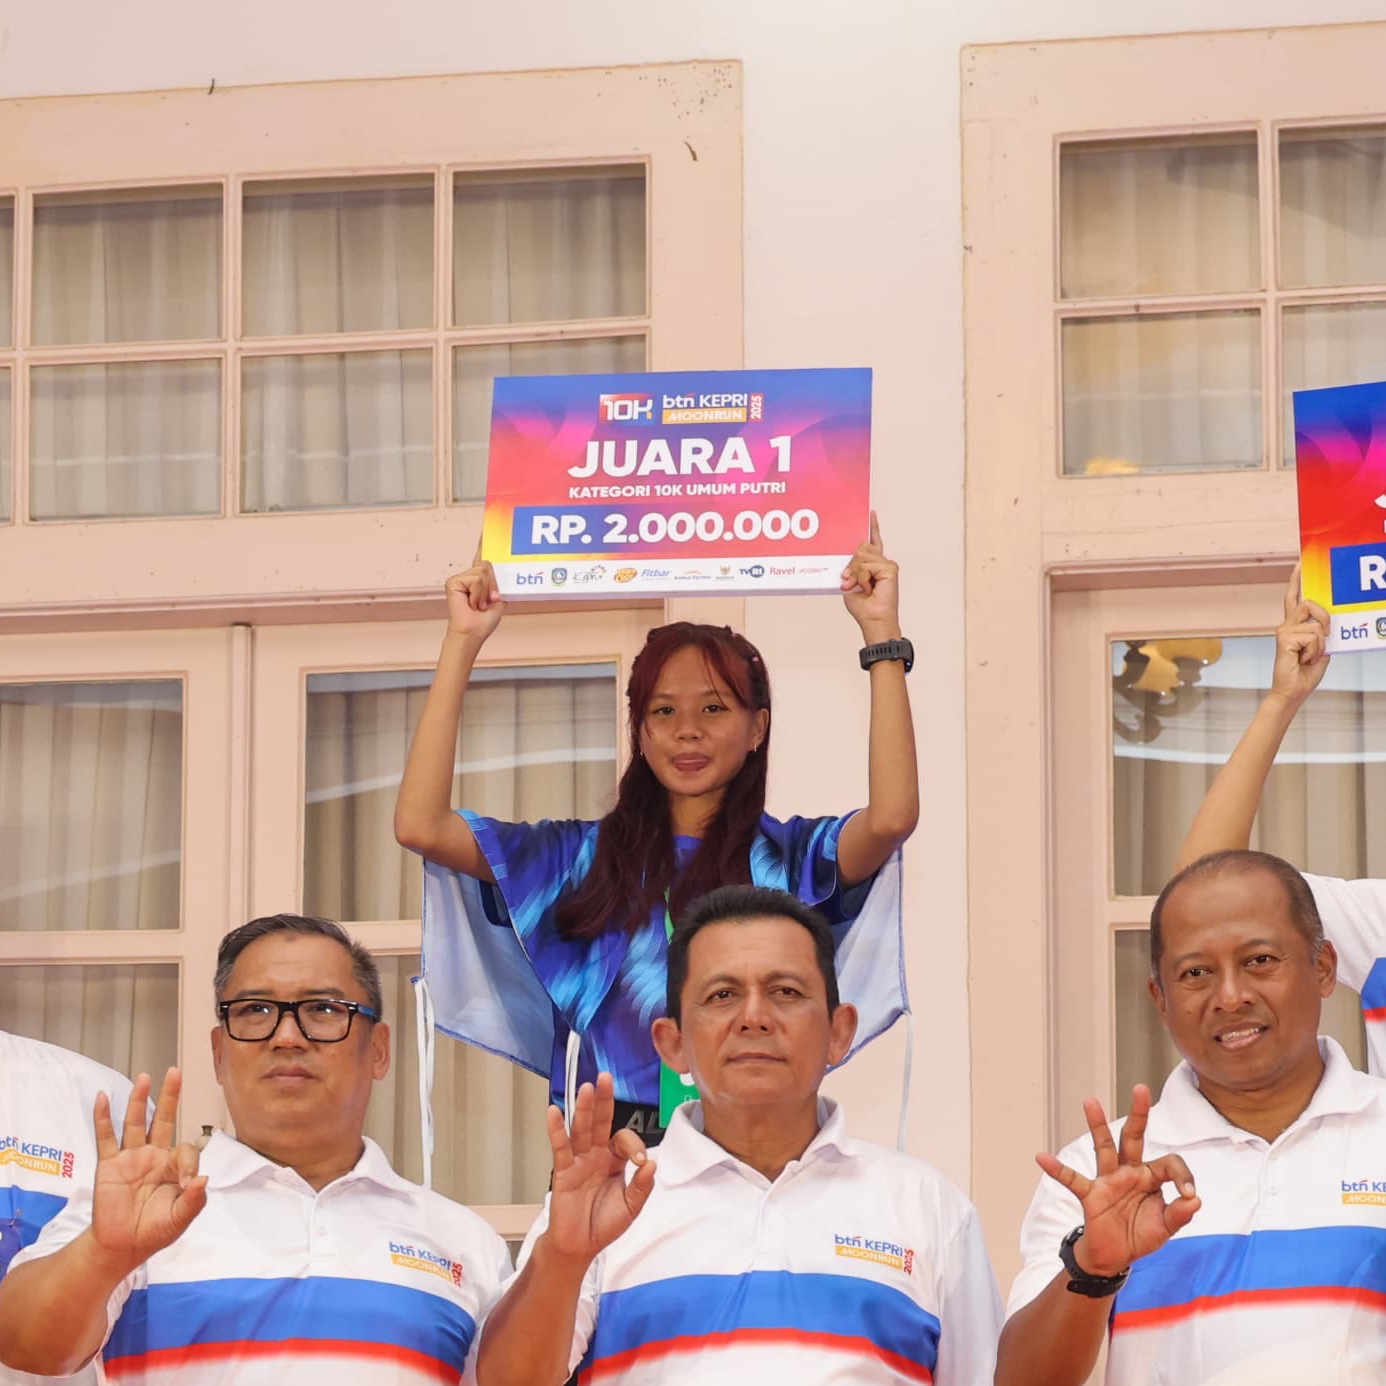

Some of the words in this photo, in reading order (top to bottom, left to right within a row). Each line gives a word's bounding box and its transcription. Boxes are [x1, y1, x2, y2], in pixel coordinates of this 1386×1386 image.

[663, 393, 695, 408] btn
[700, 394, 747, 408] KEPRI
[750, 395, 762, 419] 2025
[668, 410, 741, 421] MOONRUN
[567, 437, 755, 477] JUARA
[770, 436, 791, 471] 1
[569, 485, 650, 498] KATEGORI
[654, 484, 682, 496] 10K
[686, 482, 736, 495] UMUM
[741, 482, 785, 493] PUTRI
[531, 515, 592, 544] RP.
[603, 509, 819, 543] 2.000.000
[517, 572, 543, 584] btn
[641, 569, 670, 577] Fitbar
[770, 567, 795, 575] Ravel
[1341, 623, 1368, 640] btn
[22, 1142, 62, 1161] KEPRI
[62, 1152, 74, 1179] 2025
[1342, 1180, 1368, 1191] btn
[835, 1234, 861, 1247] btn
[865, 1240, 903, 1256] KEPRI
